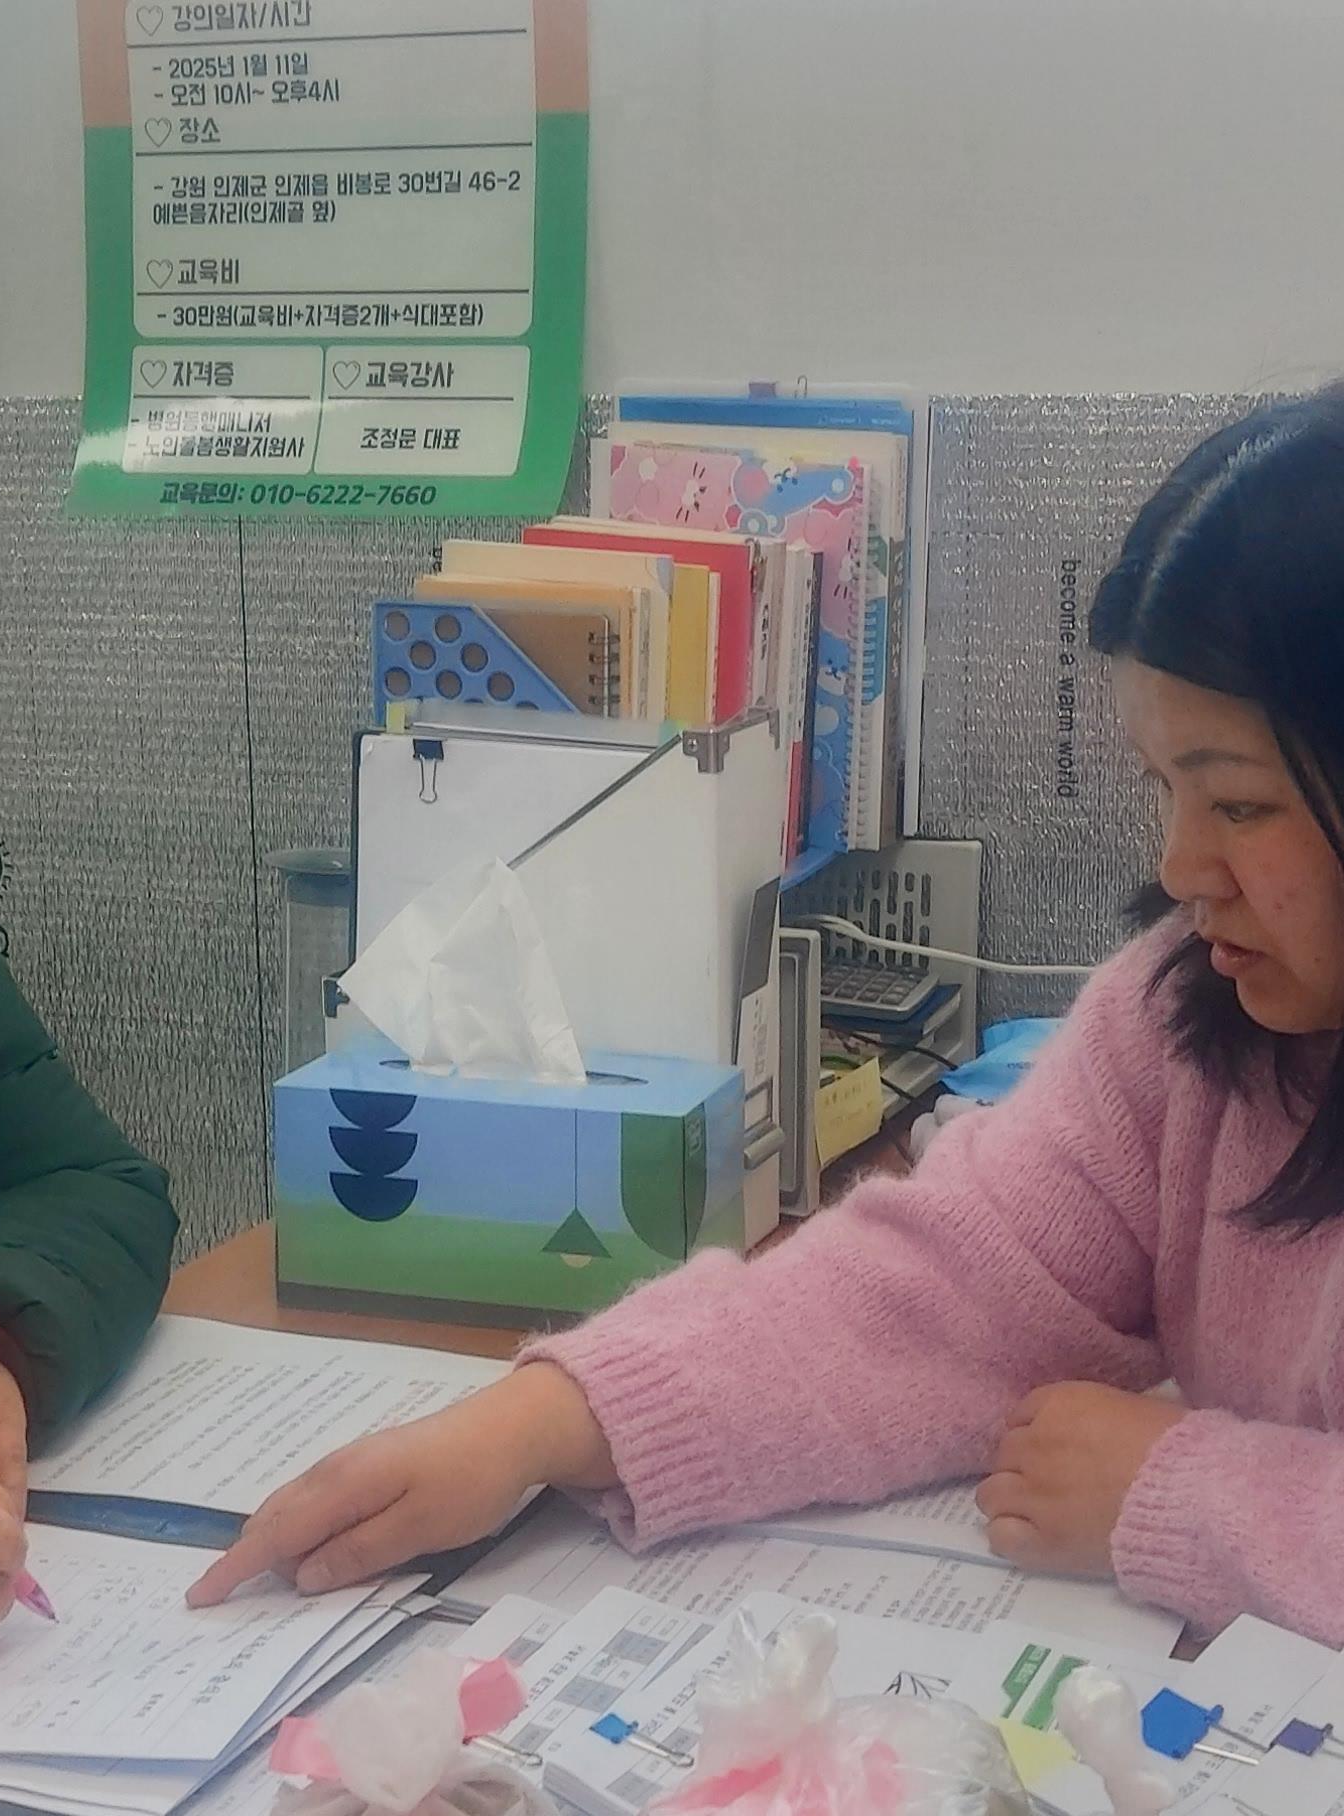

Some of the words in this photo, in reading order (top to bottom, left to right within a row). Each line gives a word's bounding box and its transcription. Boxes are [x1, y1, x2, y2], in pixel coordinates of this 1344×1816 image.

[172, 0, 312, 32] 강의일자/시간
[169, 55, 235, 79] 2025년
[243, 53, 268, 77] 1월
[275, 52, 309, 76] 11일
[171, 83, 206, 106] 오전
[272, 78, 340, 103] 오후4시
[178, 116, 222, 144] 장소
[171, 175, 206, 198] 강원
[213, 174, 268, 198] 인제군
[275, 173, 328, 197] 인제읍
[337, 172, 392, 196] 비봉로
[398, 170, 462, 194] 30번길
[468, 170, 521, 192] 46-2
[177, 258, 240, 285] 교육비
[173, 361, 234, 387] 자격증
[365, 360, 454, 388] 교육강사
[423, 427, 462, 449] 대표
[250, 483, 437, 505] 010-6222-7660
[1059, 558, 1081, 645] become
[1059, 653, 1077, 667] a
[1057, 677, 1077, 732] warm
[1056, 741, 1079, 798] world
